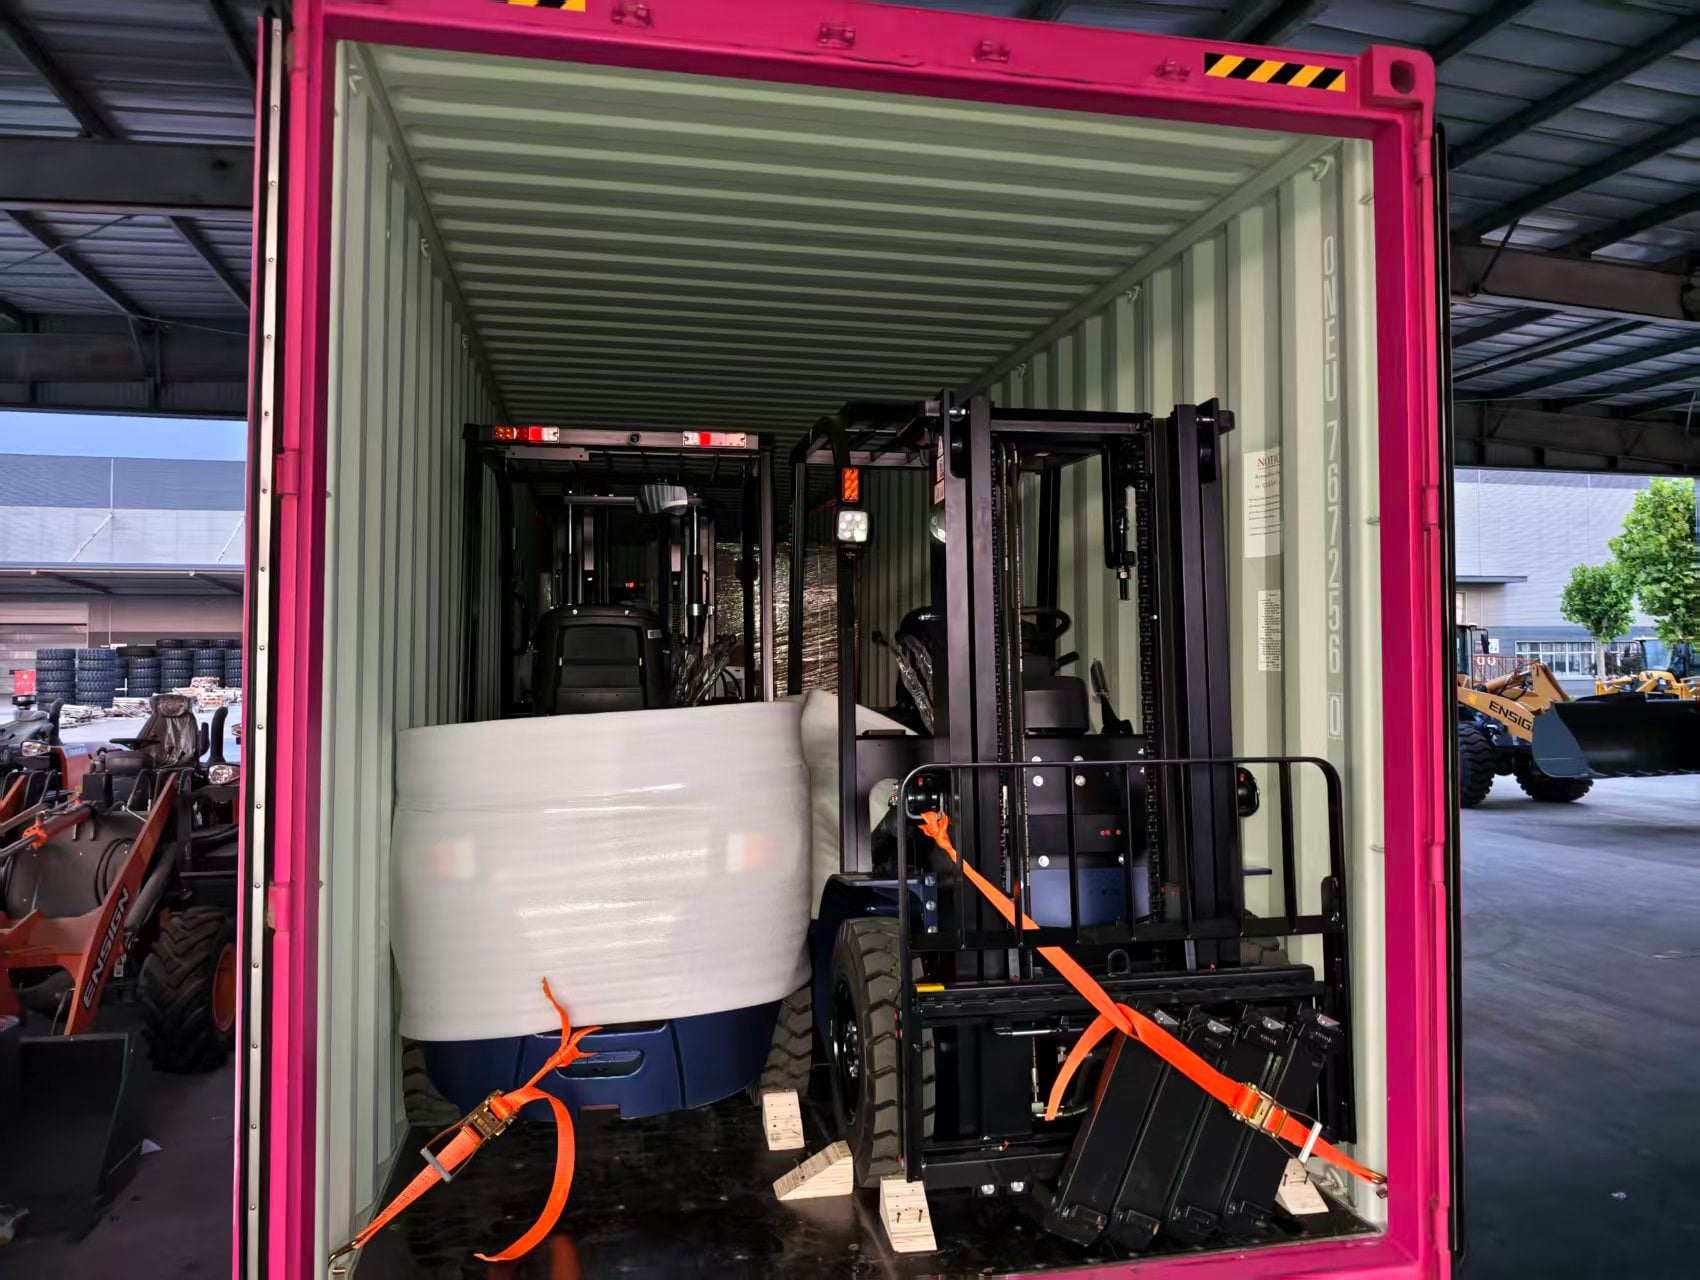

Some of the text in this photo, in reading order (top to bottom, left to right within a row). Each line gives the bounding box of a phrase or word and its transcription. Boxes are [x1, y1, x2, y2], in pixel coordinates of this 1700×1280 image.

[1323, 235, 1338, 402] ONEU
[1326, 419, 1341, 674] 767256
[83, 886, 129, 1009] ENSIGN
